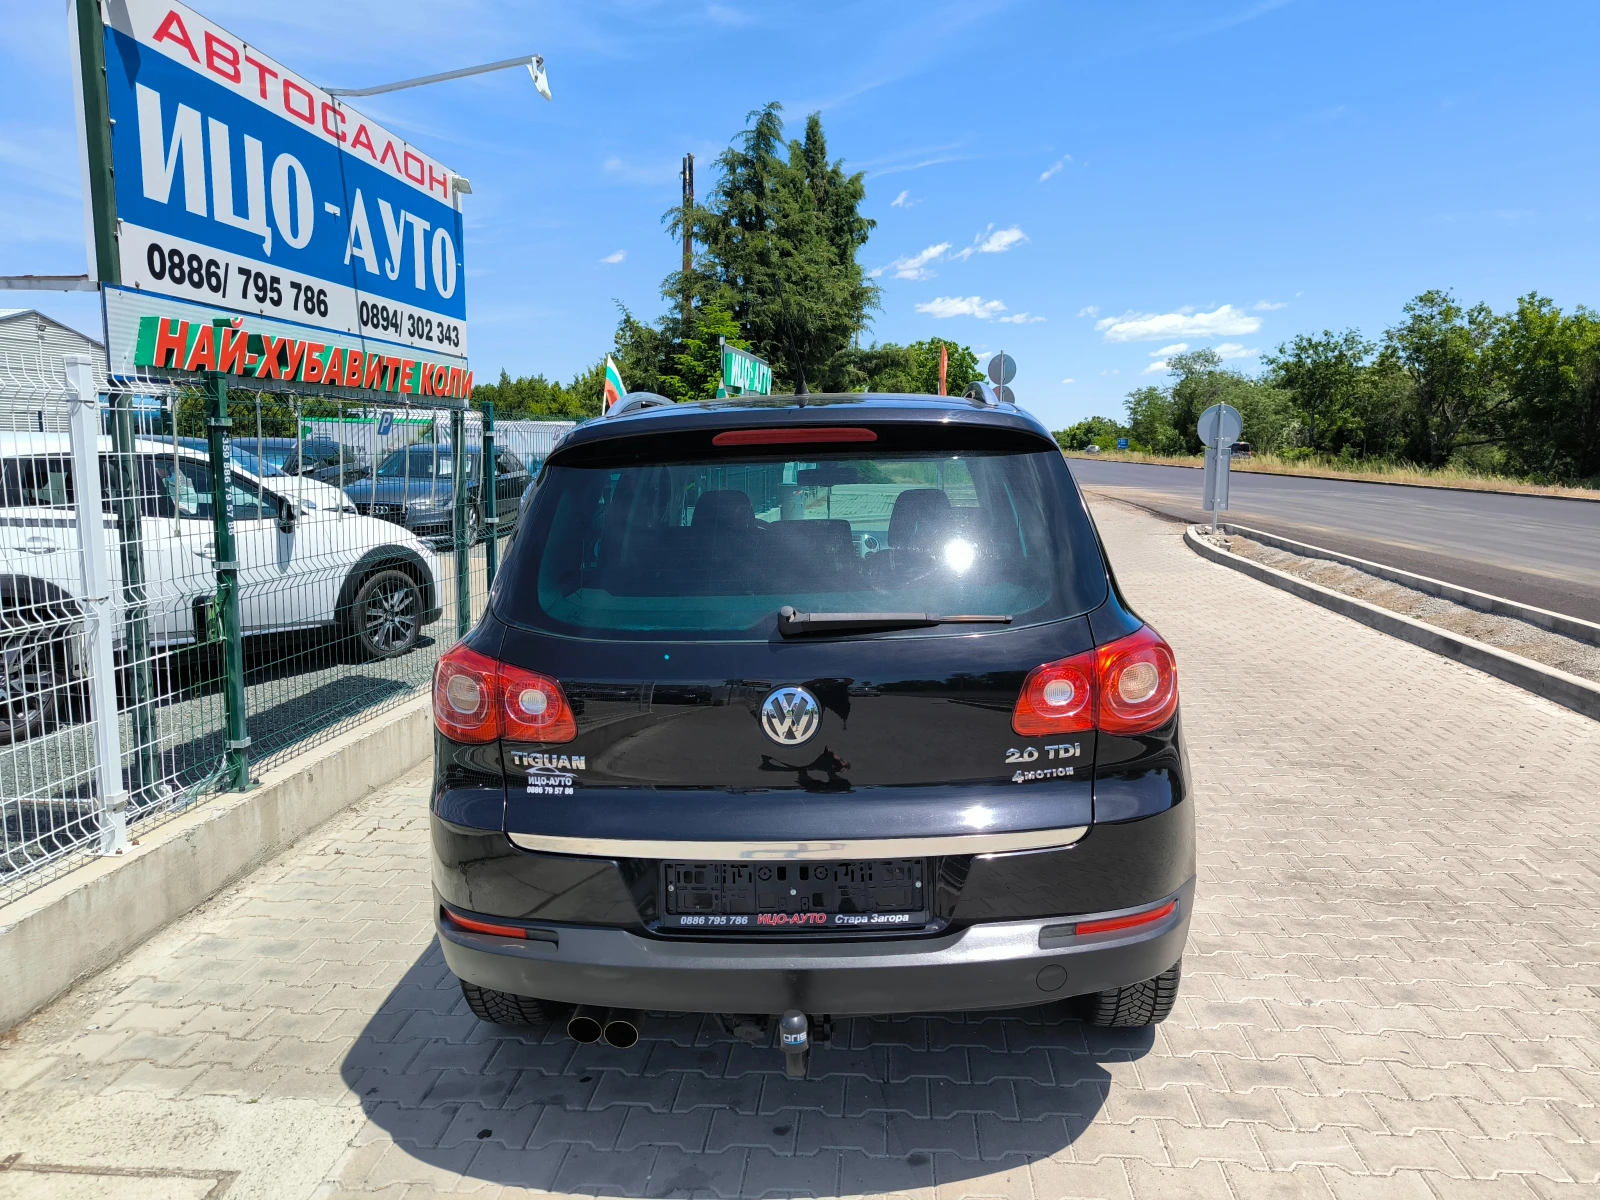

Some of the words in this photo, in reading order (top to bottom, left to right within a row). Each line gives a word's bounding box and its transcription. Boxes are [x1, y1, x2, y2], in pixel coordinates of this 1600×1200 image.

[152, 9, 449, 200] АВТОСАЛОН
[147, 242, 230, 299] 0886/
[237, 266, 283, 308] 795
[289, 280, 329, 318] 786
[360, 300, 404, 337] 0894/
[407, 313, 433, 342] 302
[436, 321, 460, 348] 343
[152, 316, 416, 394] НАЙ-ХУБАВИТЕ
[418, 361, 473, 401] КОЛИ
[380, 415, 391, 433] P
[222, 429, 230, 459] +359
[223, 461, 232, 484] 886
[225, 486, 233, 501] 79
[226, 504, 234, 518] 57
[228, 521, 235, 536] 86
[511, 751, 586, 770] TIGUAN
[528, 776, 572, 786] ИЦО-АУТО
[1011, 766, 1074, 784] 4MOTION
[526, 786, 543, 794] 0886
[554, 787, 563, 795] 57
[564, 787, 574, 795] 86
[680, 916, 705, 925] 0886
[708, 916, 727, 925] 795
[729, 916, 749, 925] 786
[757, 913, 827, 925] ИЦО-АУТО
[834, 914, 868, 924] Стара
[870, 913, 909, 923] Загора
